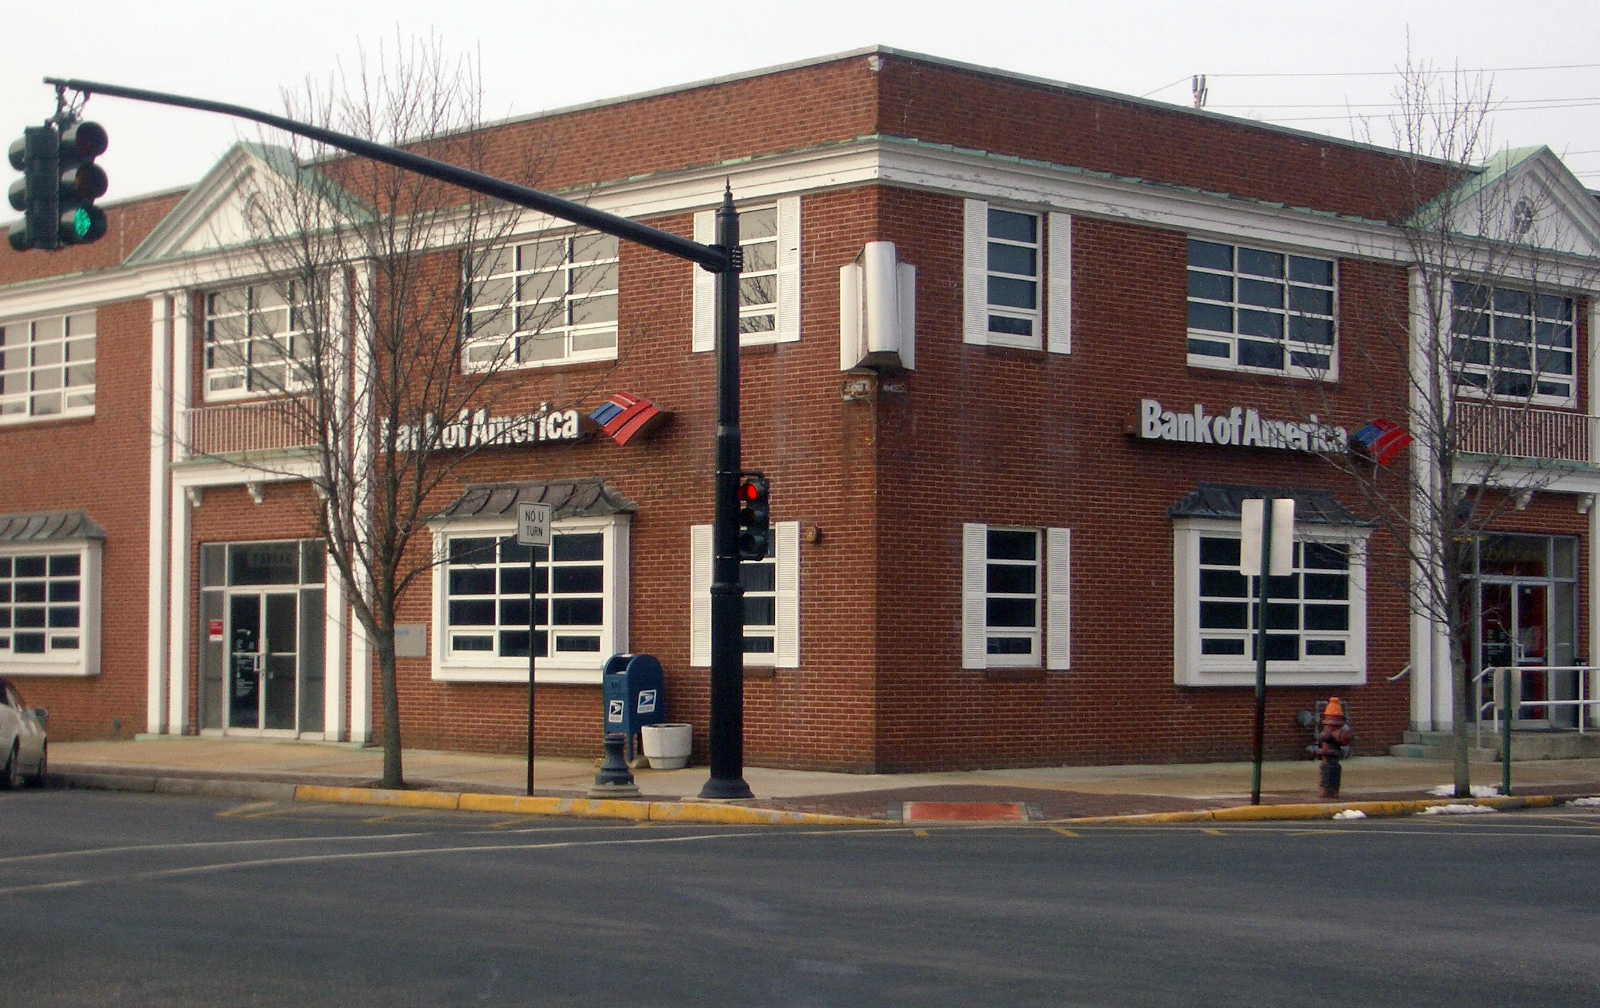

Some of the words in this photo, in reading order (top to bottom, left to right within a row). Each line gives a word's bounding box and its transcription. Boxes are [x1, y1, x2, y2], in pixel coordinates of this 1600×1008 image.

[442, 409, 470, 449] of
[469, 402, 579, 446] America
[1140, 399, 1213, 444] Bank
[1213, 406, 1243, 446] of
[1243, 408, 1349, 454] America
[525, 510, 536, 523] NO
[538, 510, 544, 523] U
[526, 525, 543, 537] TURN
